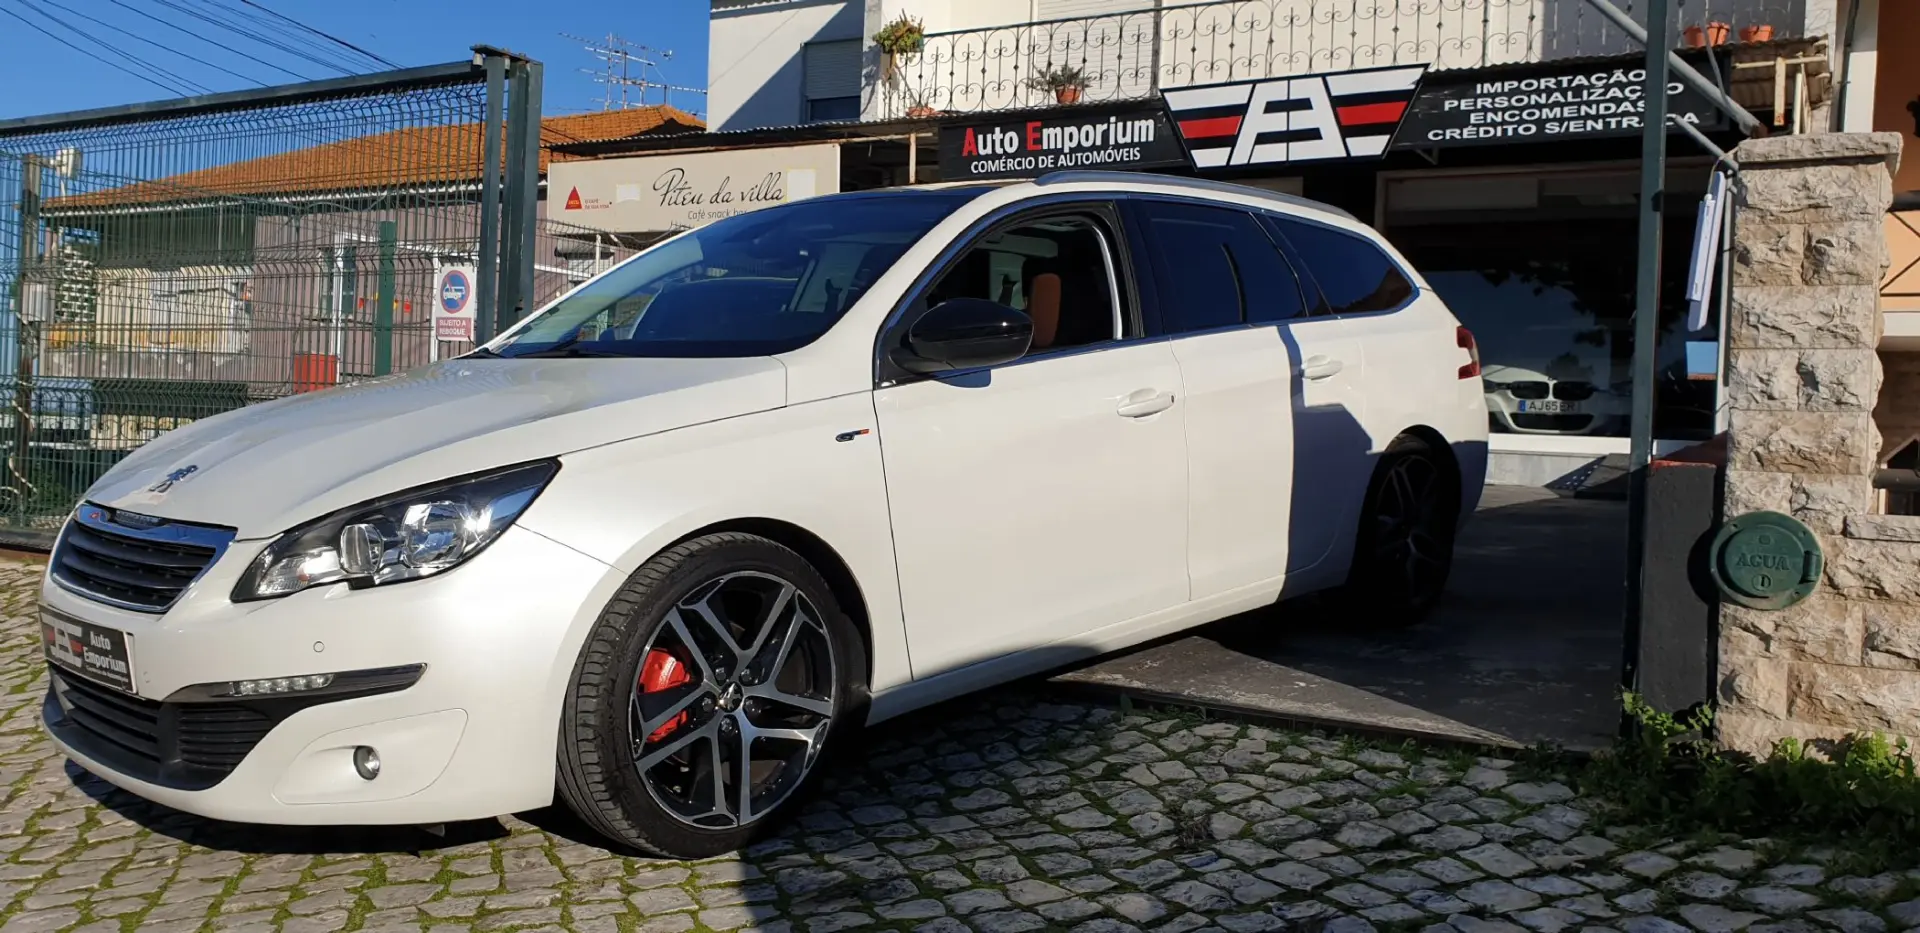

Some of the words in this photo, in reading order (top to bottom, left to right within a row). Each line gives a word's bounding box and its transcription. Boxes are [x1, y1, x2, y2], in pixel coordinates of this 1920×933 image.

[1475, 69, 1646, 94] IMPORTAÇÃO
[1443, 83, 1684, 111] PERSONALIZAÇO
[962, 127, 1019, 157] Auto
[1025, 116, 1155, 154] Emporium
[1427, 125, 1537, 140] CRÉDITO
[1544, 112, 1700, 134] S/ENTRA
[970, 155, 1035, 174] COMÉRCIO
[1038, 156, 1054, 169] DE
[1057, 147, 1141, 167] AUTOMÓVEIS
[652, 167, 705, 207] Piteu
[709, 175, 735, 204] da
[740, 171, 786, 202] villa
[688, 209, 706, 221] Café
[707, 209, 730, 220] snack
[90, 630, 112, 651] Auto
[83, 646, 128, 674] Emporium
